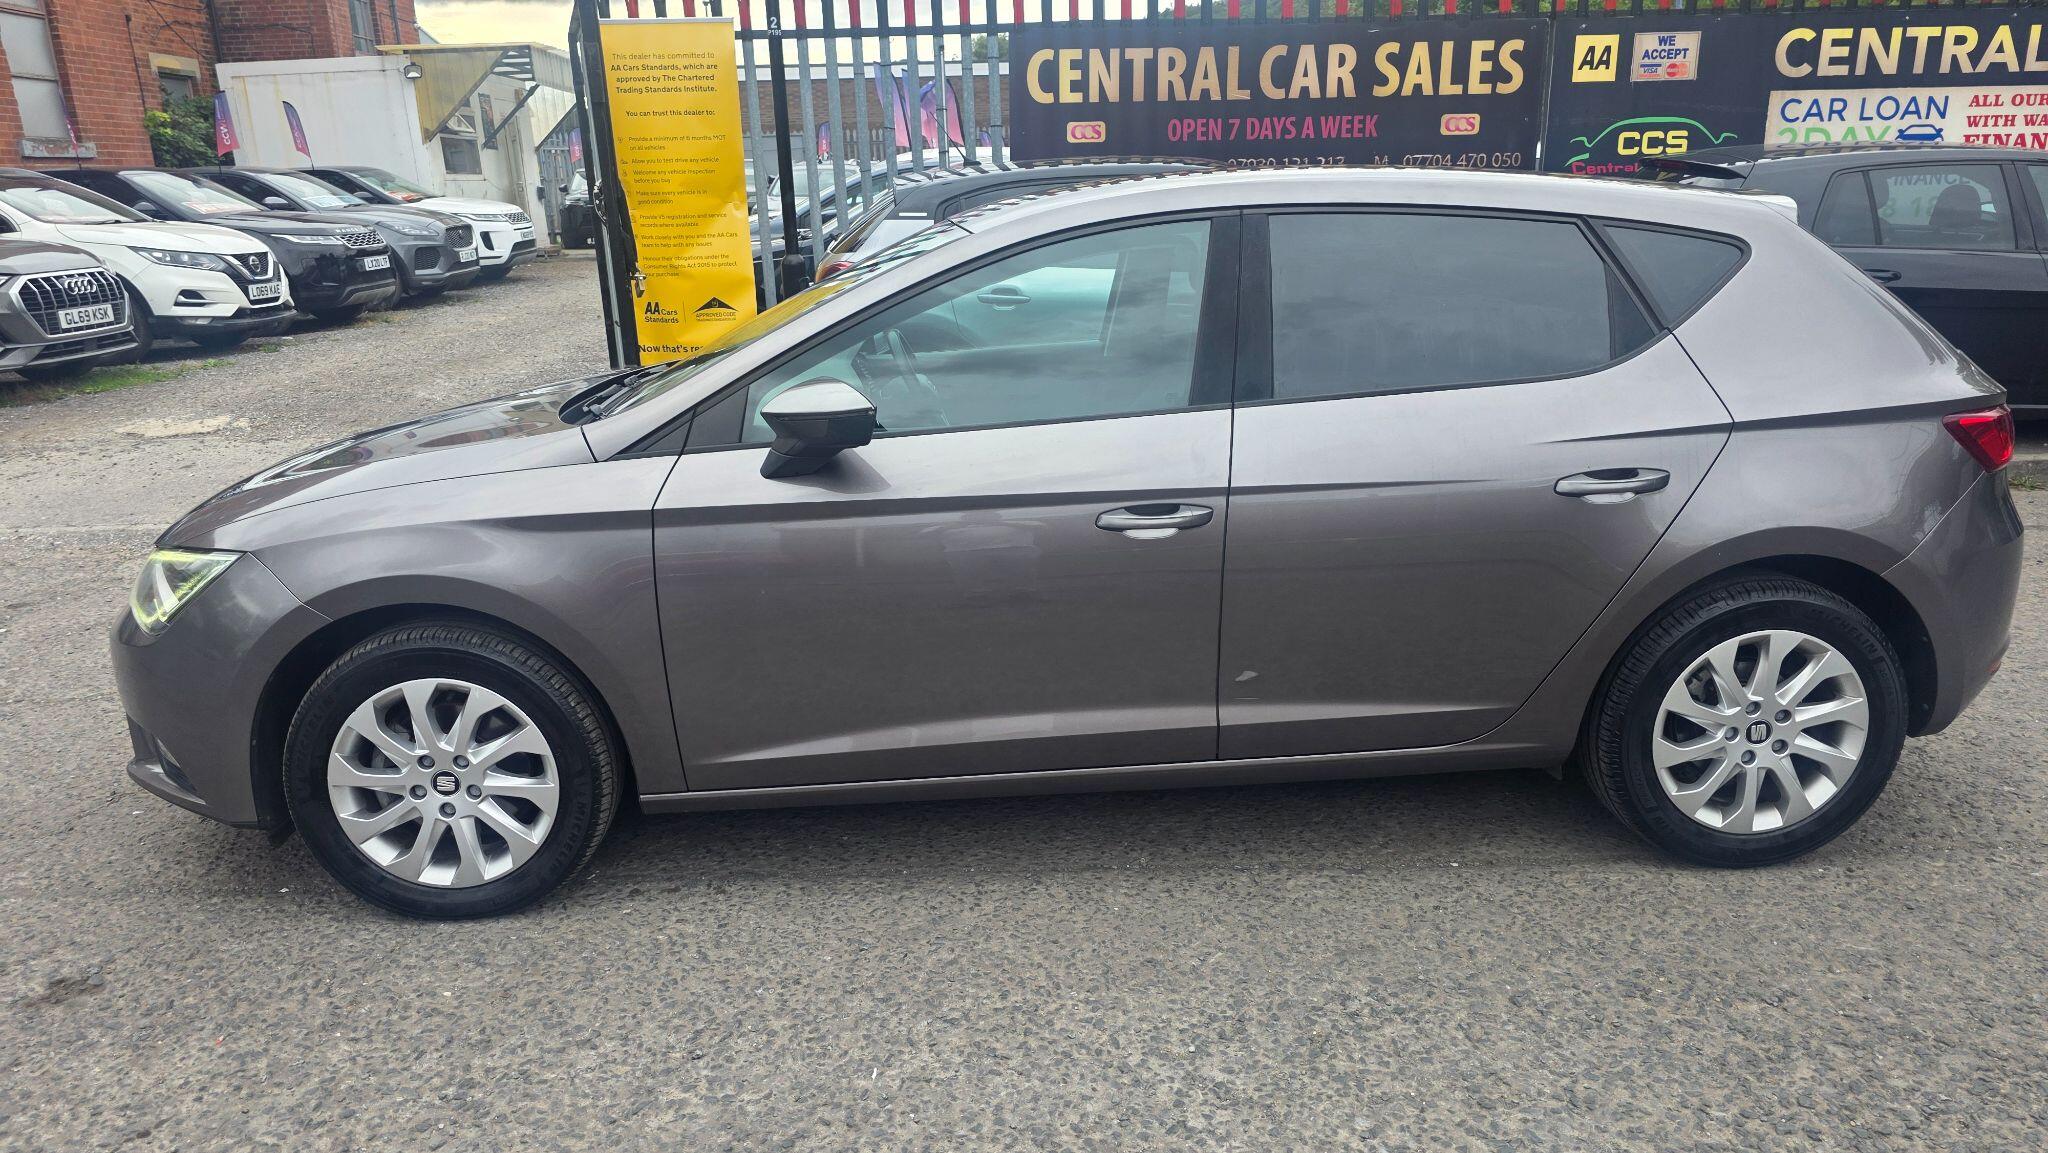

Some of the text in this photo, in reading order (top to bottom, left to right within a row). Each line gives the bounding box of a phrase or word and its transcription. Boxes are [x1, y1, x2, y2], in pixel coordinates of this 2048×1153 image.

[770, 16, 778, 28] 2
[1658, 35, 1676, 46] WE
[1578, 45, 1612, 70] AA
[1642, 48, 1689, 60] ACCEPT
[1775, 24, 2048, 78] CENTRAL
[1026, 38, 1525, 104] CENTRAL CAR SALES
[1968, 94, 2048, 107] ALL OUR
[1780, 96, 1949, 123] CAR LOAN
[1966, 114, 2017, 127] WITH
[1168, 114, 1379, 142] OPEN 7 DAYS A WEEK
[1617, 130, 1688, 156] CCS
[1403, 154, 1452, 166] 07704
[1457, 153, 1486, 168] 470
[1492, 152, 1521, 167] 050
[1571, 162, 1640, 175] Central
[645, 302, 660, 314] AA
[64, 306, 111, 326] GL69 KSK
[662, 344, 688, 352] that's
